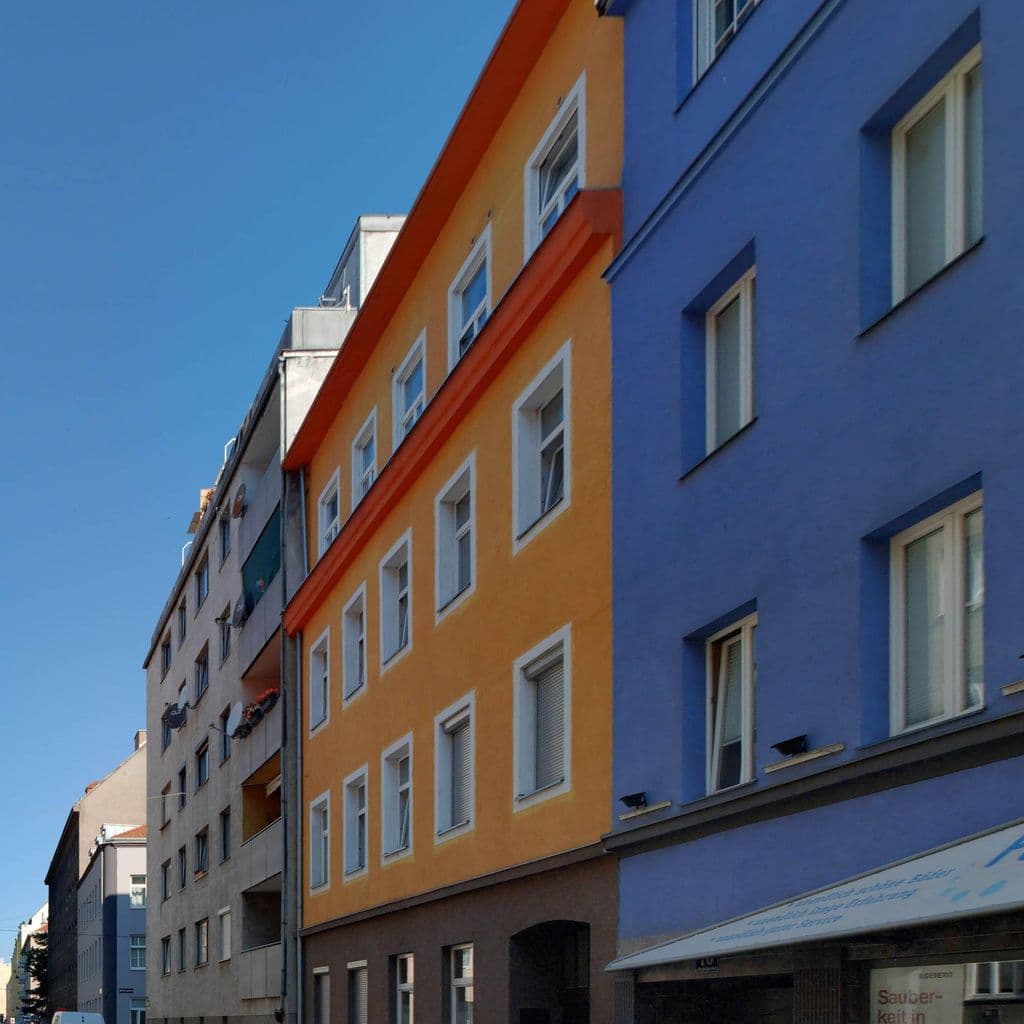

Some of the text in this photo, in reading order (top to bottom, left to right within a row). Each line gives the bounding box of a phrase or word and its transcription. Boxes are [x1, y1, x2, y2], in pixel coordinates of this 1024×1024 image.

[878, 989, 943, 1005] Sauber-
[877, 1009, 925, 1024] keit in
